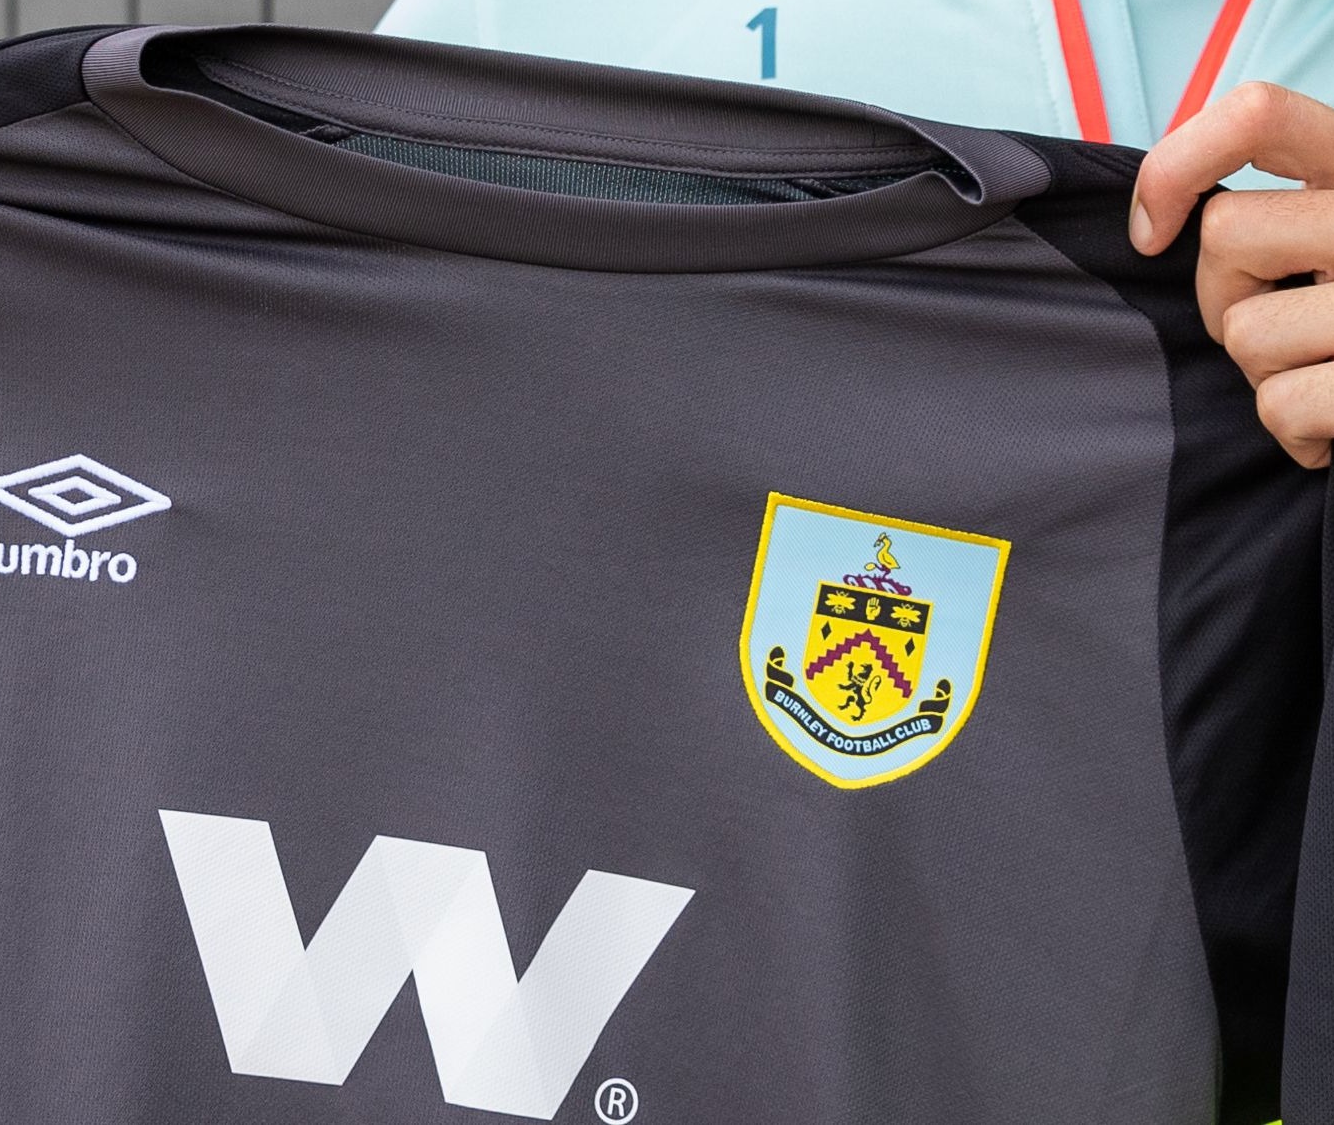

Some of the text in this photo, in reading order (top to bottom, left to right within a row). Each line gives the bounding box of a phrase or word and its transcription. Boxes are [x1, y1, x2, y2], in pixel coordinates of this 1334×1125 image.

[745, 7, 777, 80] 1
[773, 689, 932, 753] BURNLEY FOOTBALL CLUB
[158, 809, 696, 1121] W
